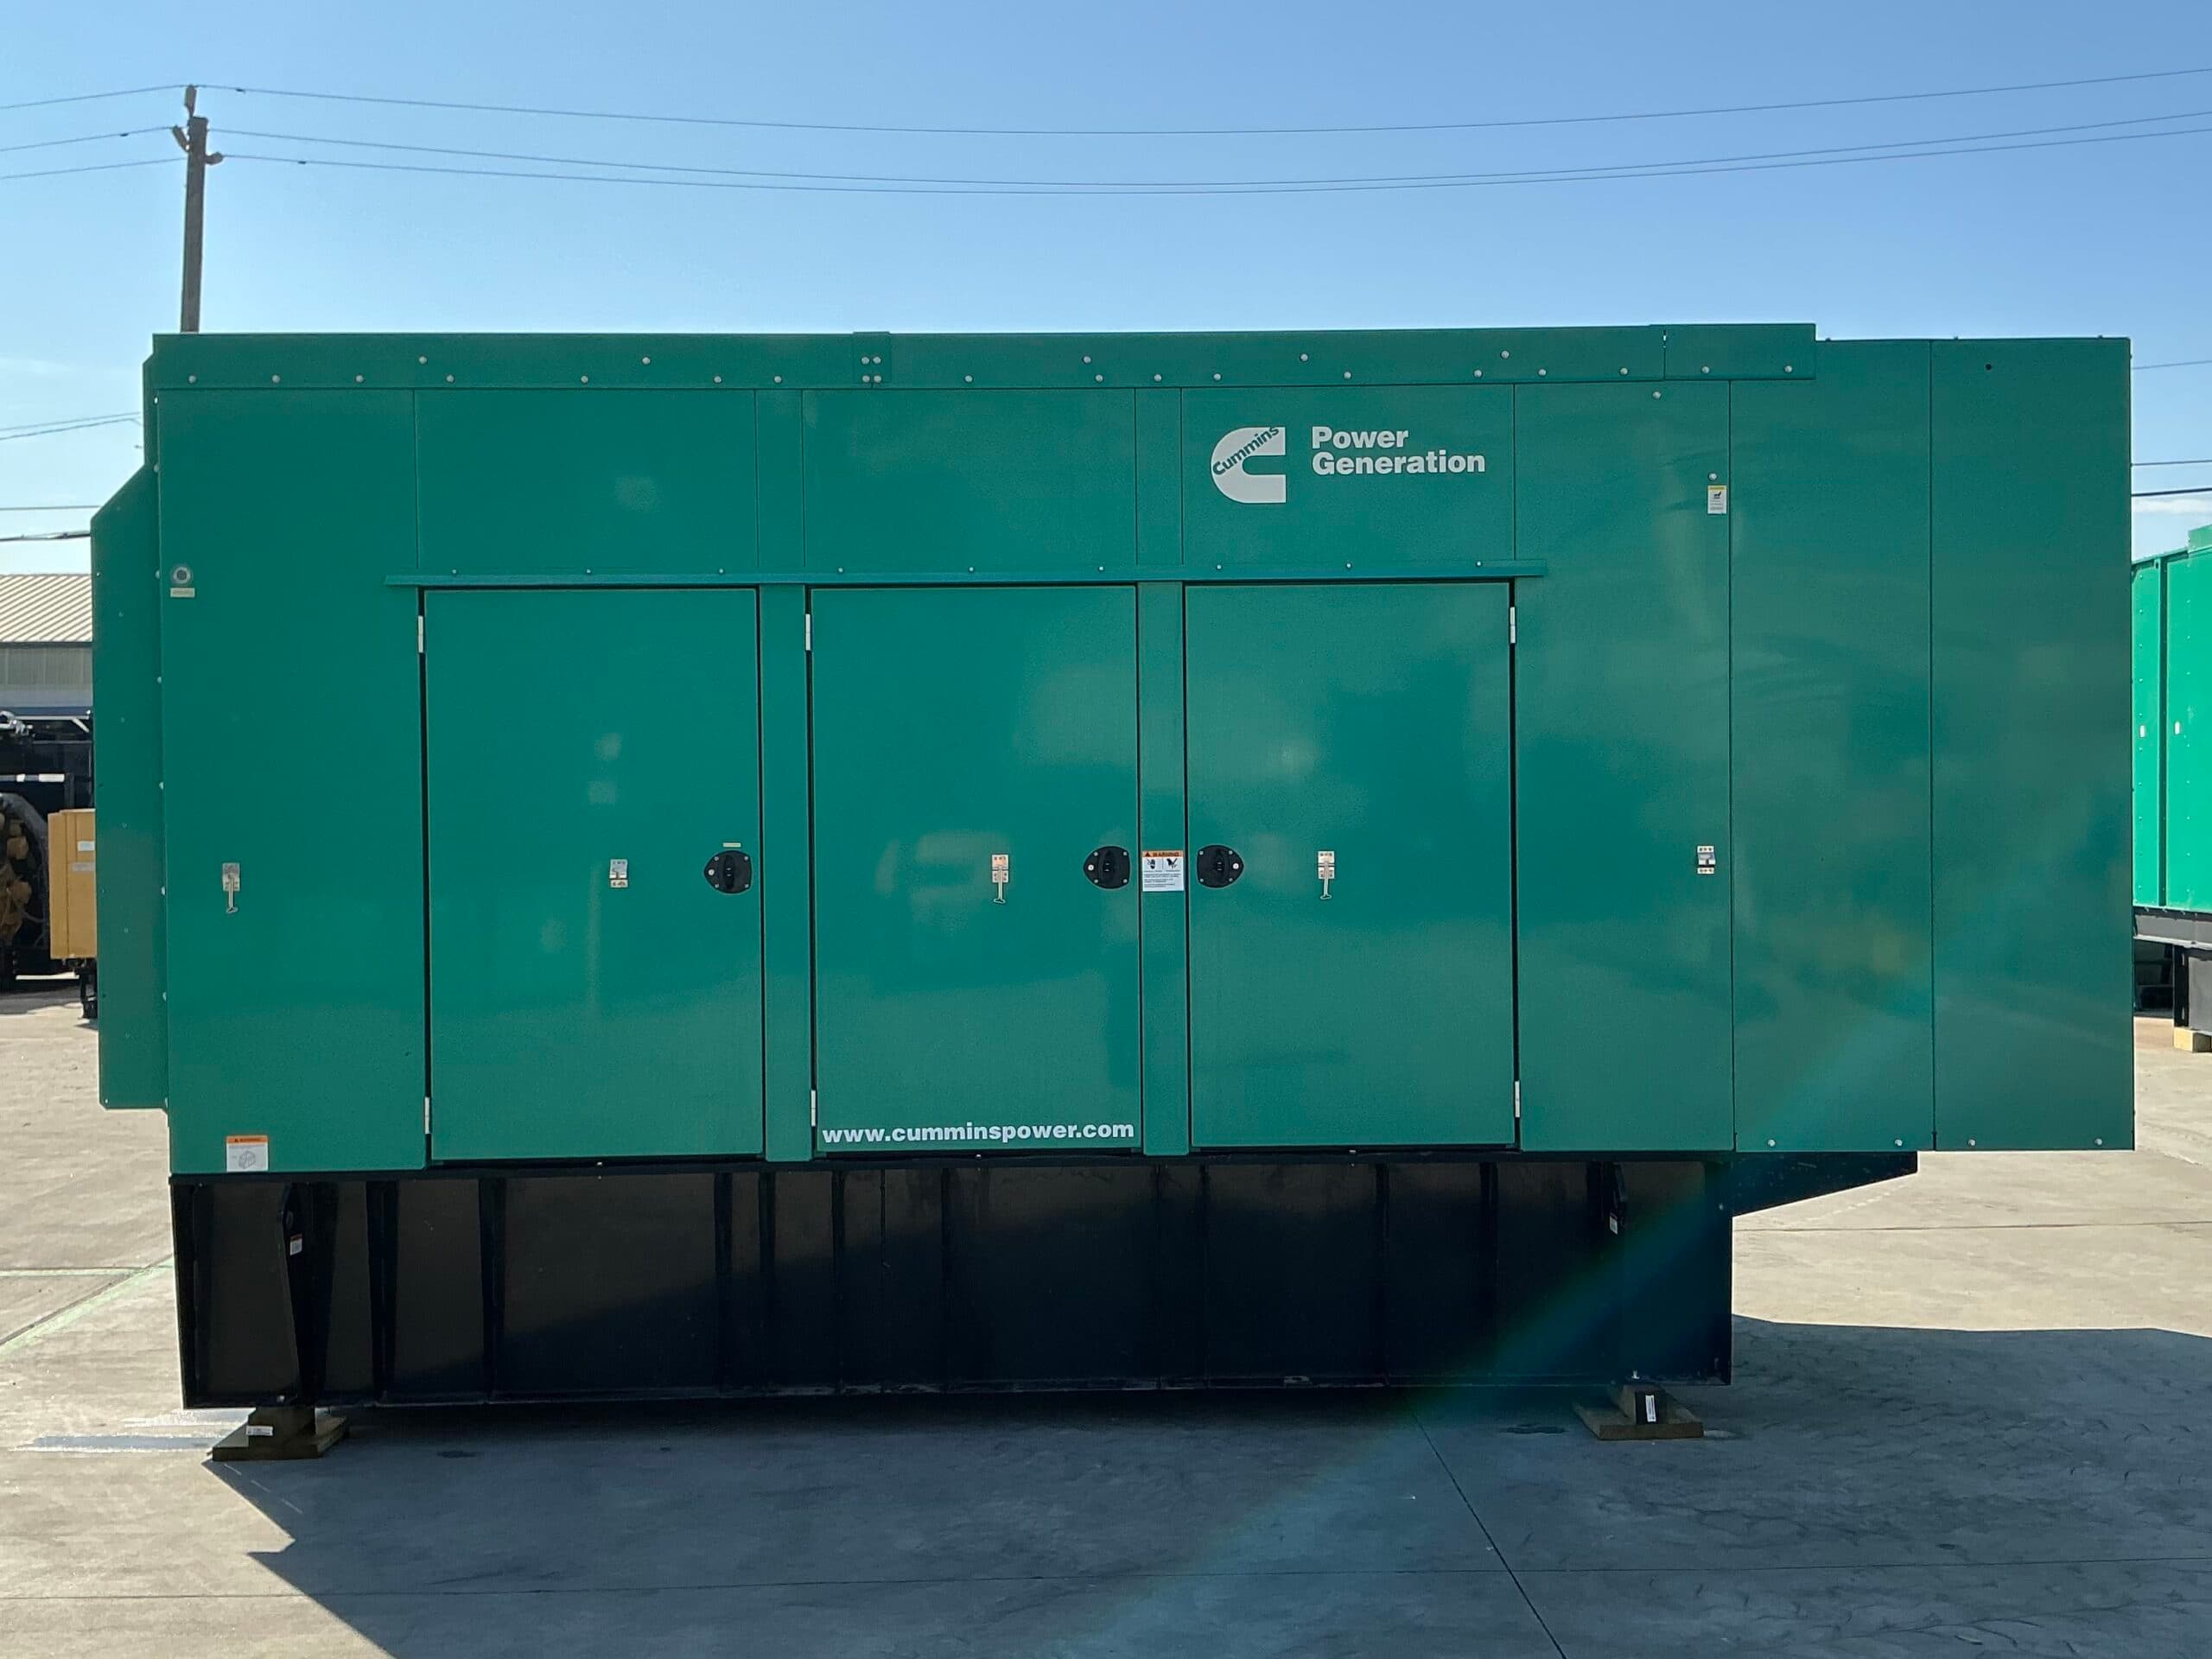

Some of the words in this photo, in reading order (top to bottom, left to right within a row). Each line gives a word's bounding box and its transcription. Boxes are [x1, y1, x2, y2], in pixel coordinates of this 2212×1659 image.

[1311, 426, 1408, 449] Power
[1211, 426, 1281, 476] Cummins
[1312, 449, 1485, 475] Generation
[822, 1122, 1135, 1142] www.cumminspower.com
